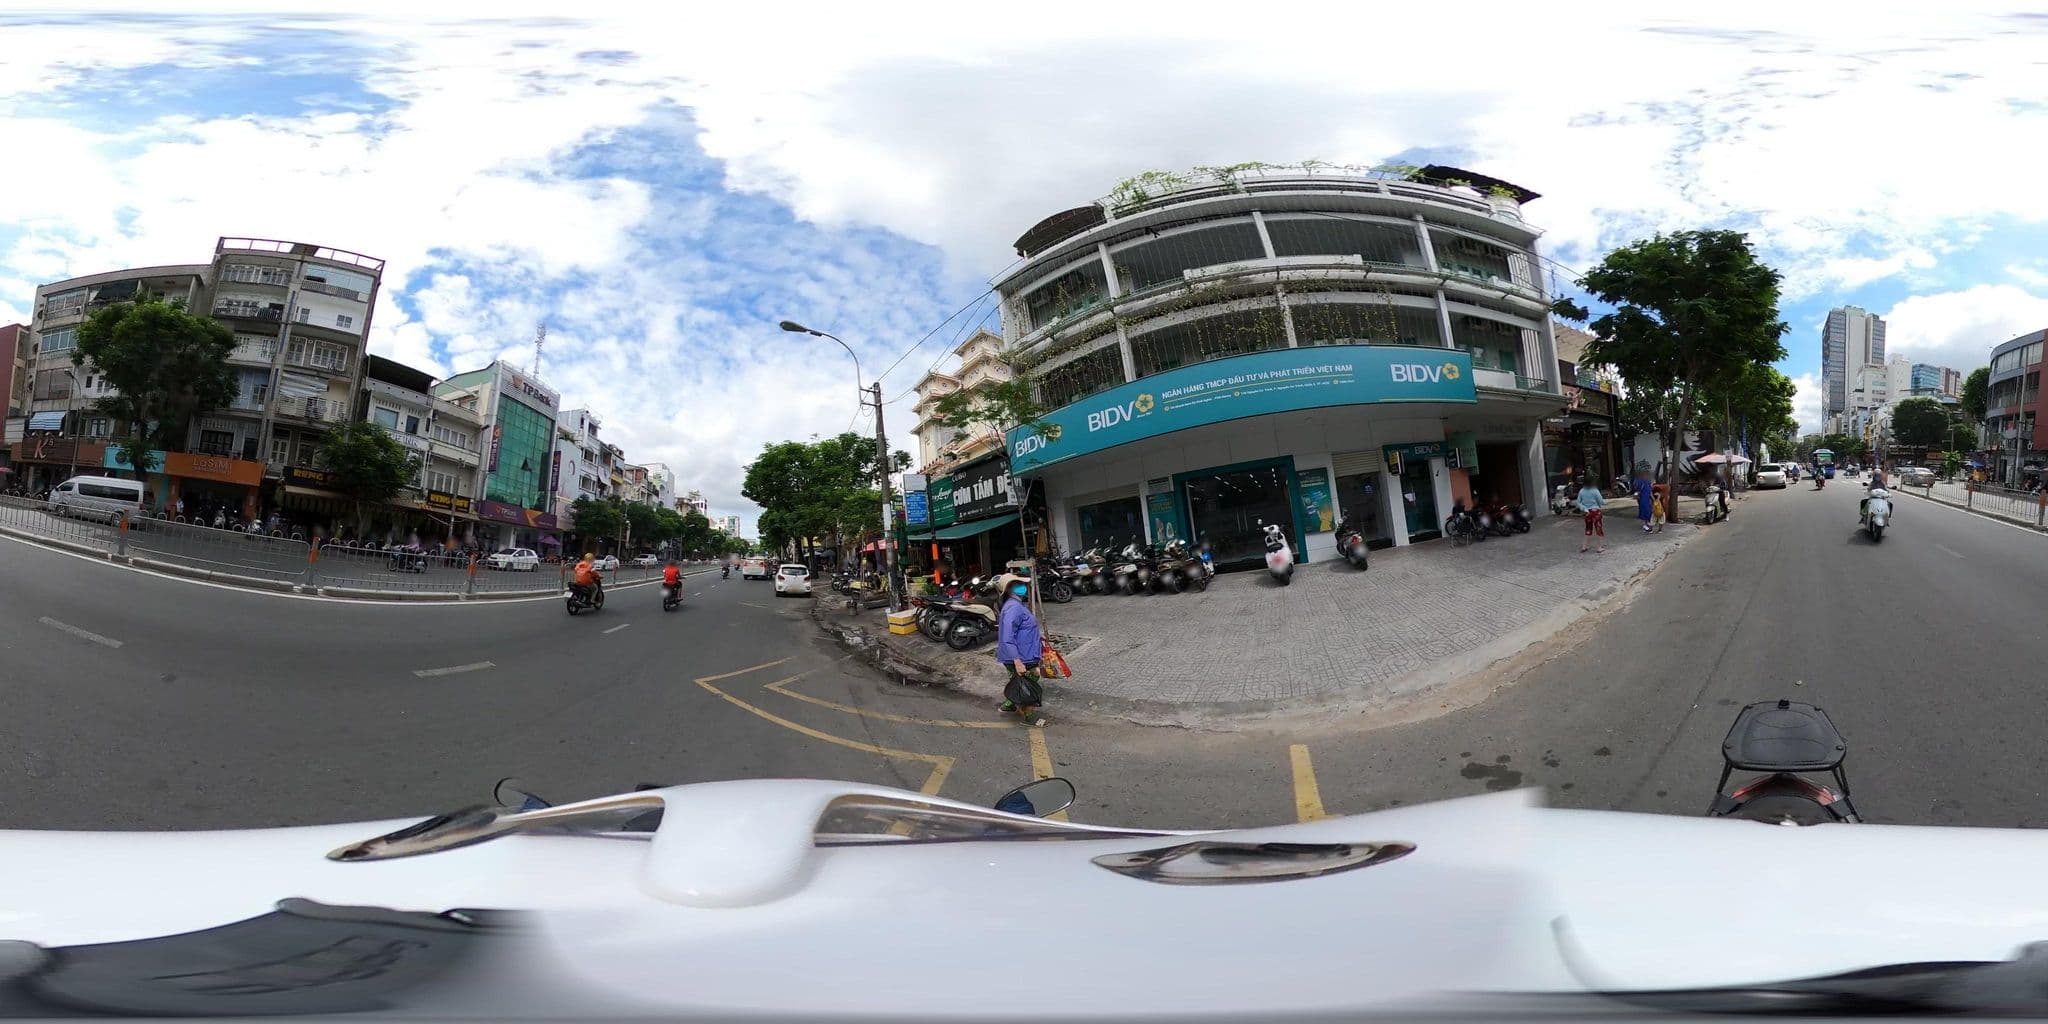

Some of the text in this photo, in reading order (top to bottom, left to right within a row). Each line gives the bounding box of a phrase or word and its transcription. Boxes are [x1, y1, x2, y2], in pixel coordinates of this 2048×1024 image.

[1162, 388, 1182, 399] NGÂN
[1206, 379, 1227, 390] TMCP
[1334, 363, 1353, 373] NAM
[1390, 363, 1442, 384] BIDV
[1087, 401, 1135, 433] BIDV
[1015, 434, 1047, 458] BIDV
[1414, 445, 1434, 456] BIDV
[953, 486, 972, 506] CƠM
[973, 475, 994, 501] TẤM
